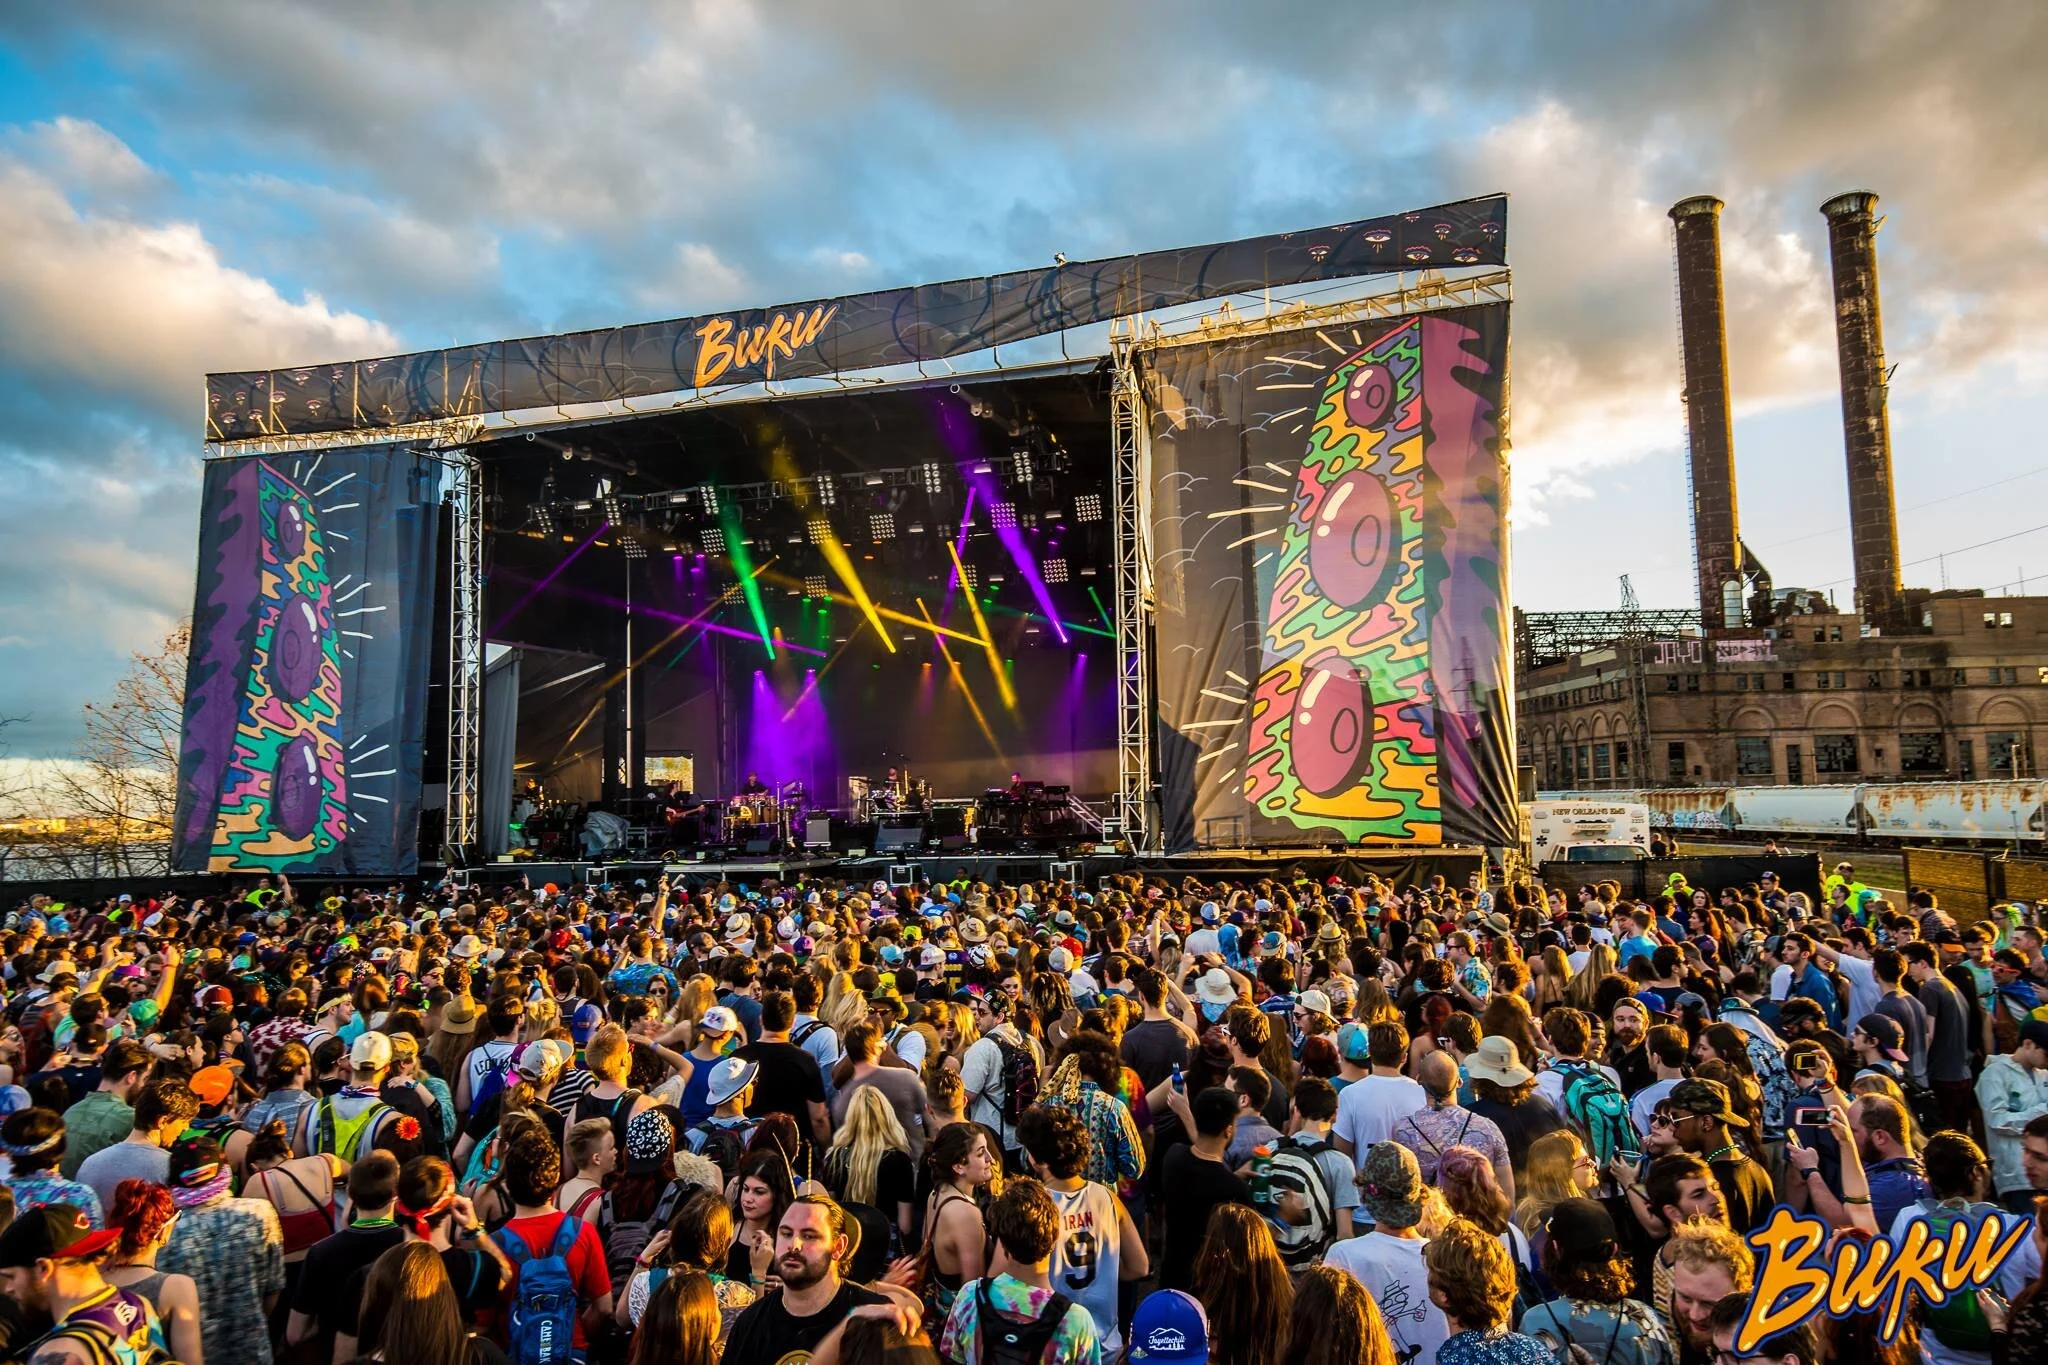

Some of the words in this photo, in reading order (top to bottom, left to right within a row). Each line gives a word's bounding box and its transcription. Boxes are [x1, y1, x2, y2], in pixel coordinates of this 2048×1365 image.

[1610, 807, 1626, 815] EMS
[1063, 1211, 1094, 1231] IRAN
[1064, 1231, 1097, 1291] 9
